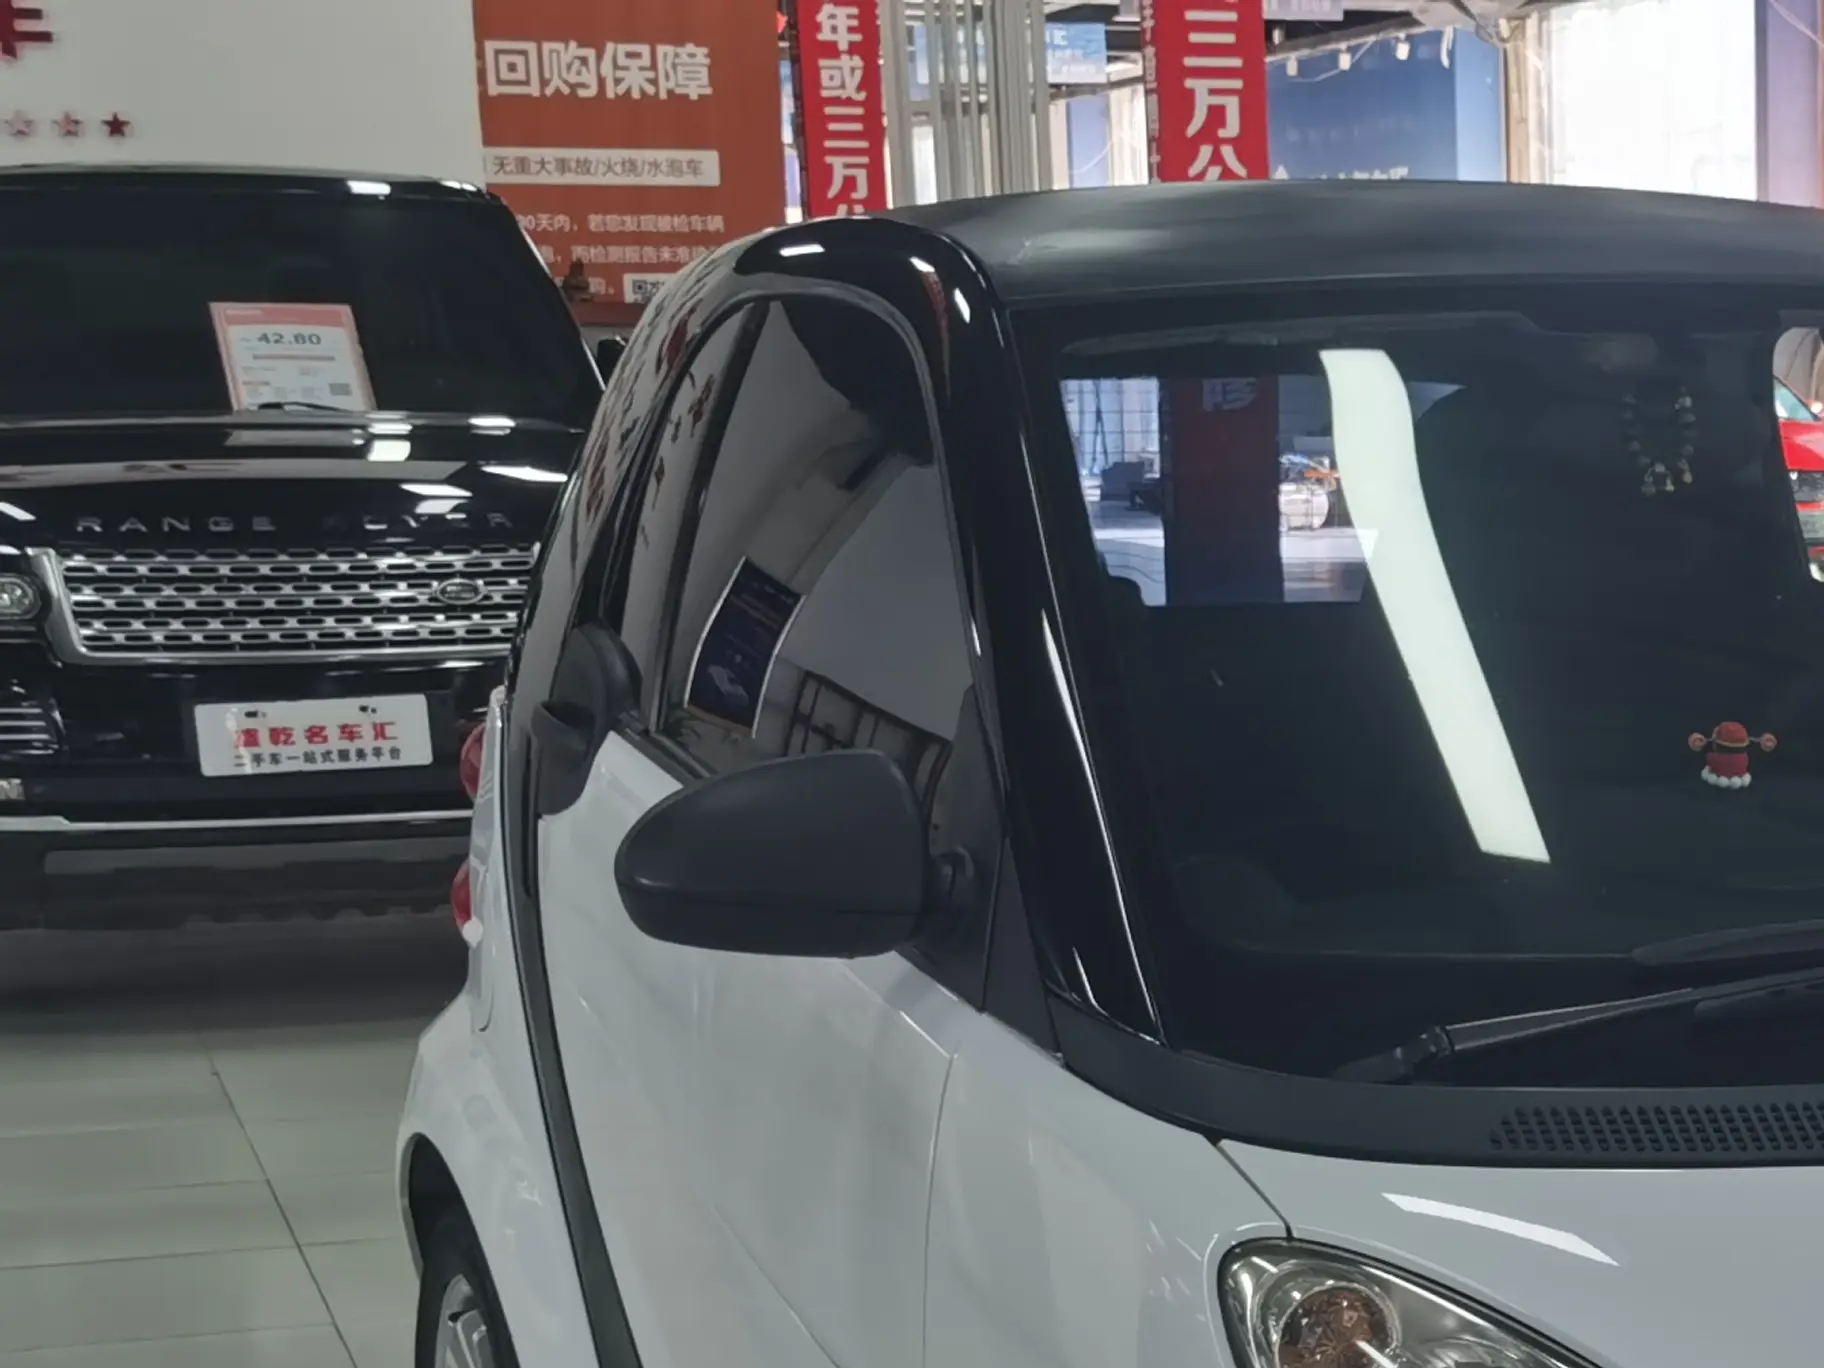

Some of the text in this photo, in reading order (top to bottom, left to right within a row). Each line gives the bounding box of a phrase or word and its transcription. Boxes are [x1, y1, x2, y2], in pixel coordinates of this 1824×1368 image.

[484, 40, 713, 100] 回购保障
[492, 154, 704, 179] 无重大事故/火烧/水泡车
[76, 515, 276, 533] RANGE
[234, 746, 402, 768] 二手车一站式服务平台
